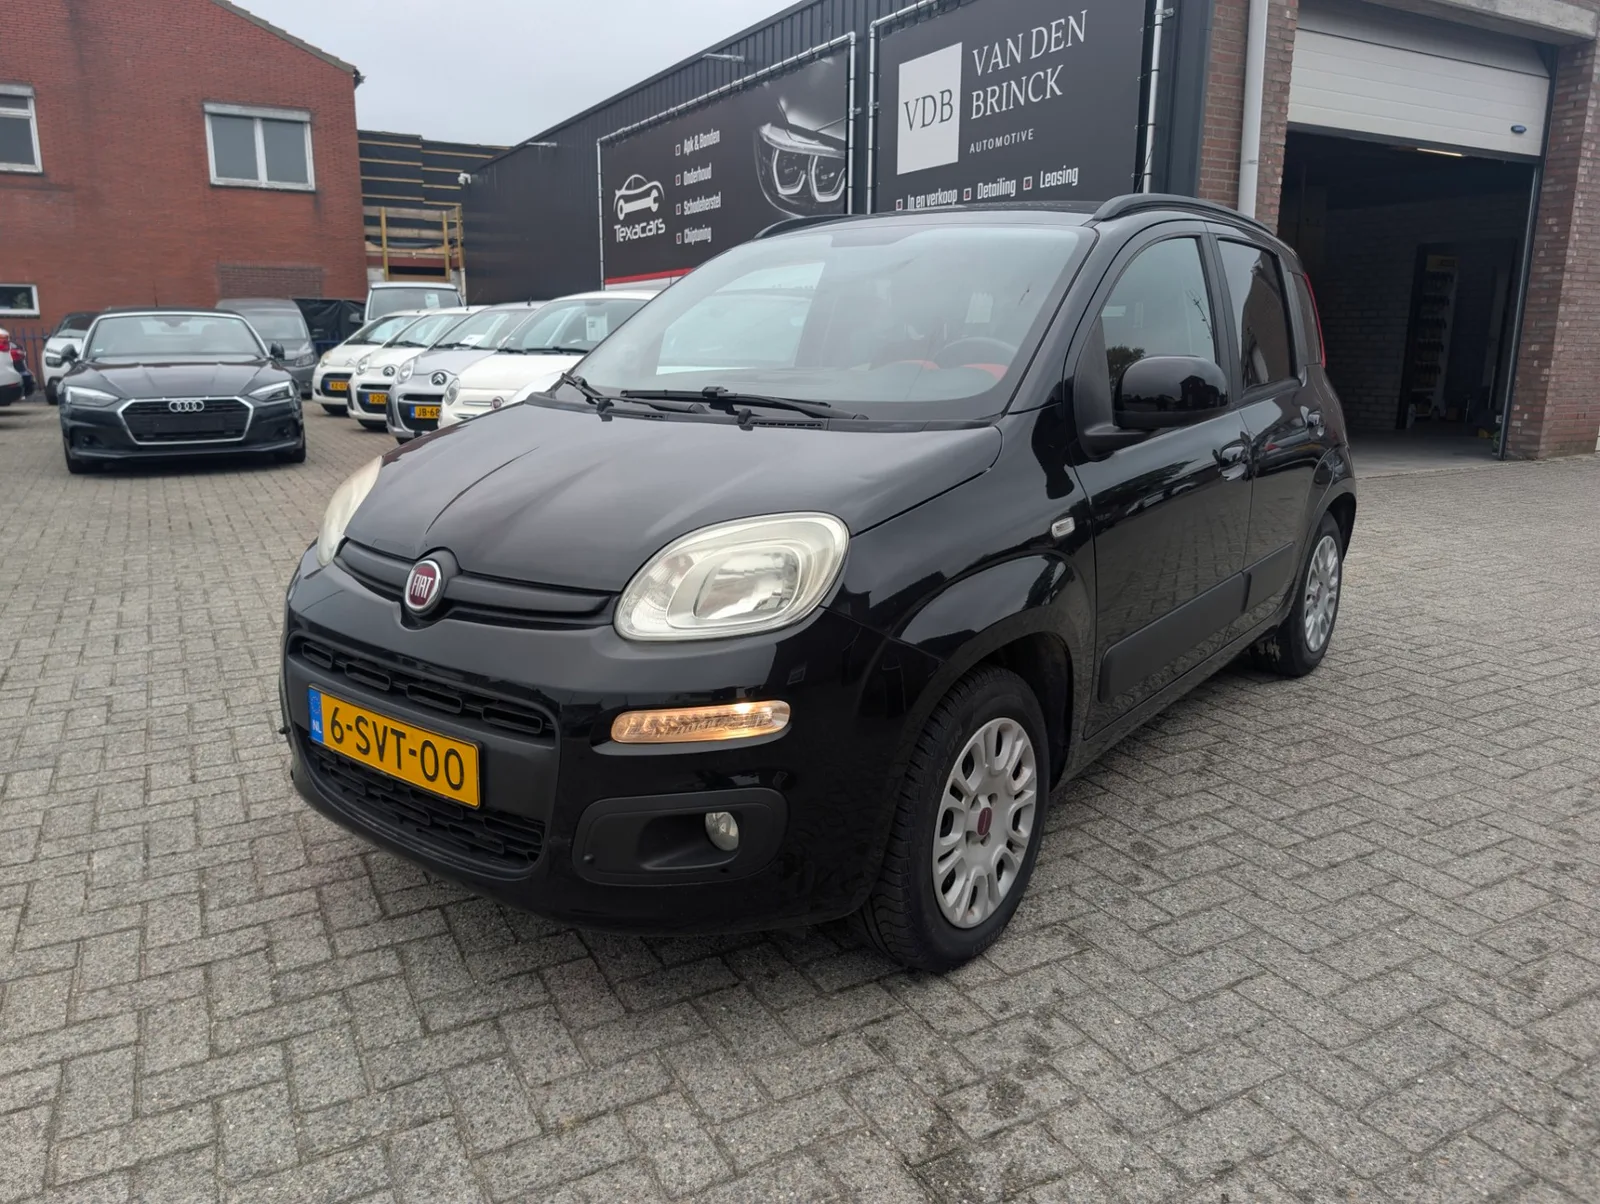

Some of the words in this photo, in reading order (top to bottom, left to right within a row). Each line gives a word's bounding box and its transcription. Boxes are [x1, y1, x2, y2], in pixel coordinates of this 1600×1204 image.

[972, 33, 1024, 77] VAN
[1029, 9, 1088, 60] DEN
[970, 64, 1064, 120] BRINCK
[903, 88, 954, 132] VDB
[969, 128, 1035, 154] AUTOMOTIVE
[977, 177, 1016, 200] Detailing
[1039, 165, 1079, 189] Leasing
[916, 196, 925, 209] en
[926, 188, 958, 207] verkoop
[411, 573, 434, 599] FIAT
[312, 718, 323, 735] NL
[330, 706, 465, 791] 6-SVT-00
